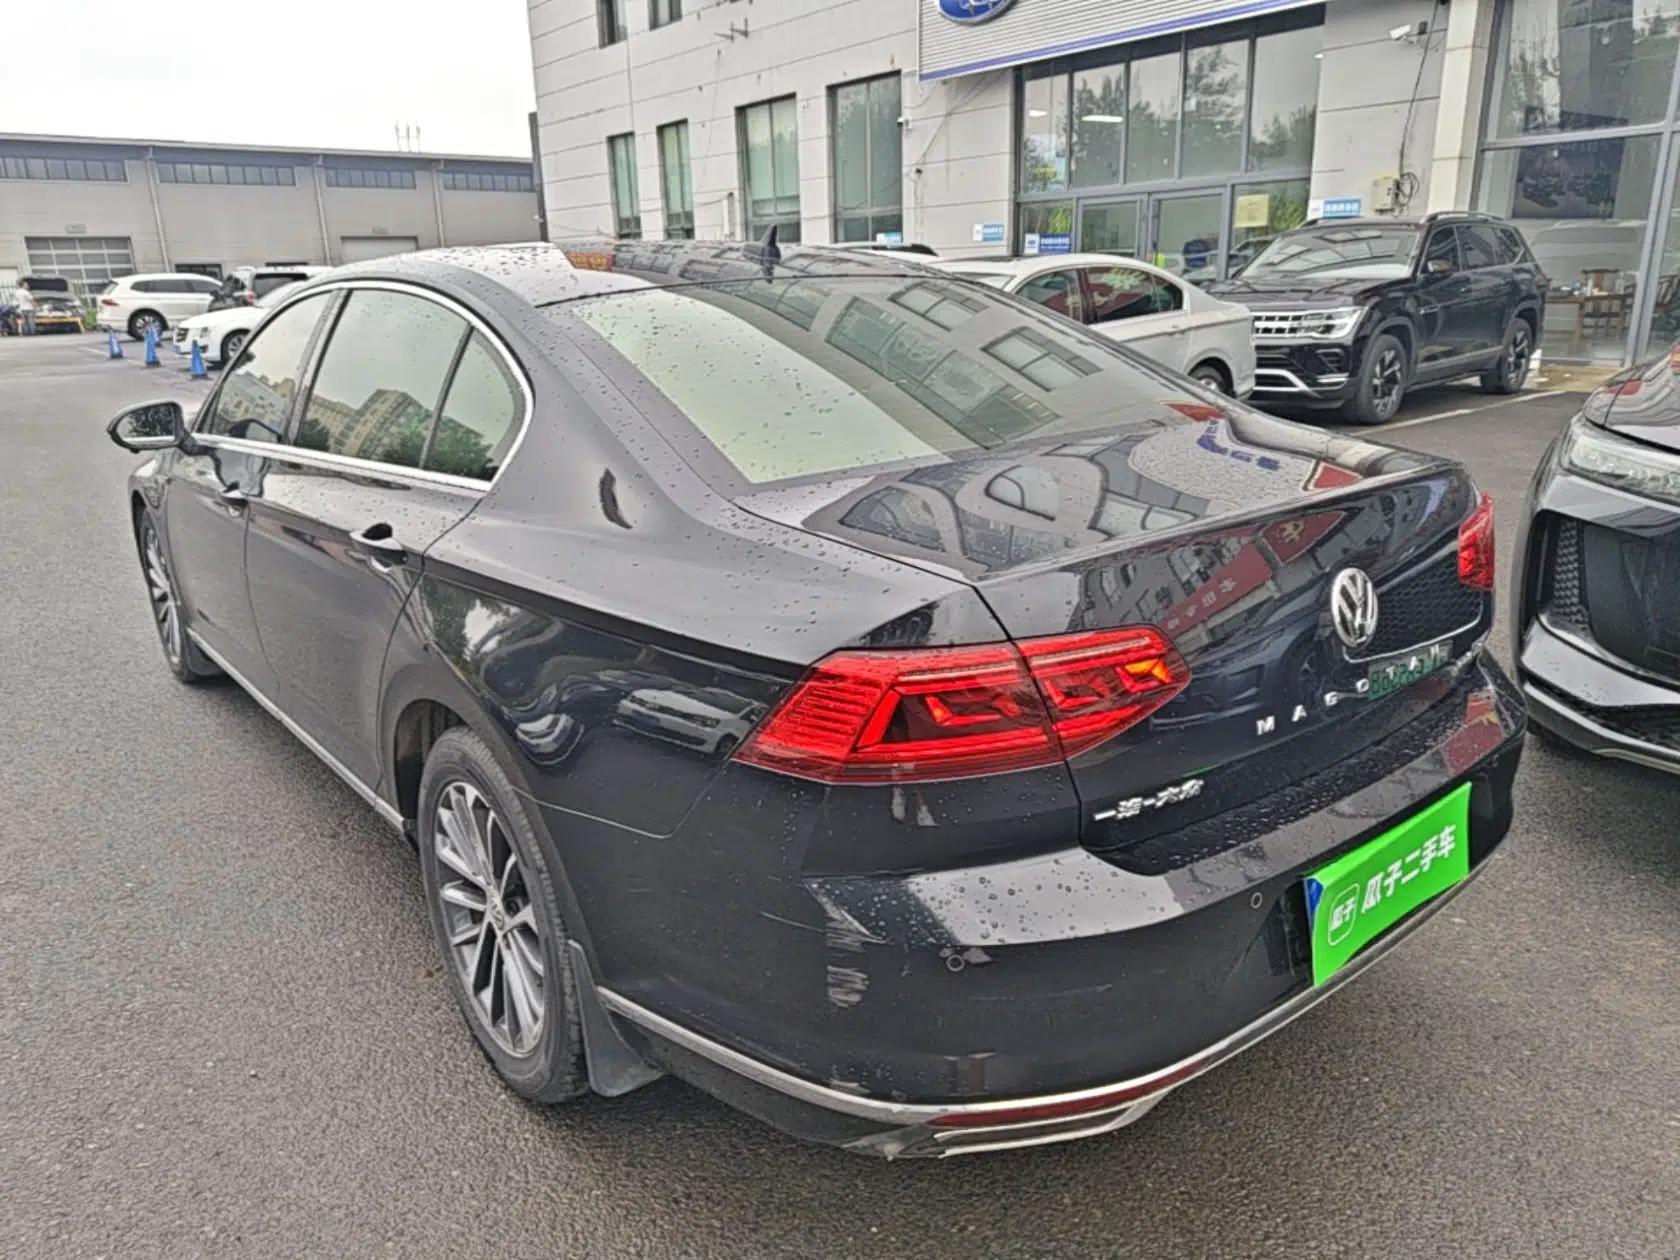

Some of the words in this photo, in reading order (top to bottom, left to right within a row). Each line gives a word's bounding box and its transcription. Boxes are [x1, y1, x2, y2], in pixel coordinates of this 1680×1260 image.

[1256, 644, 1440, 735] MAGOTAN
[1361, 824, 1456, 914] 瓜子二手车
